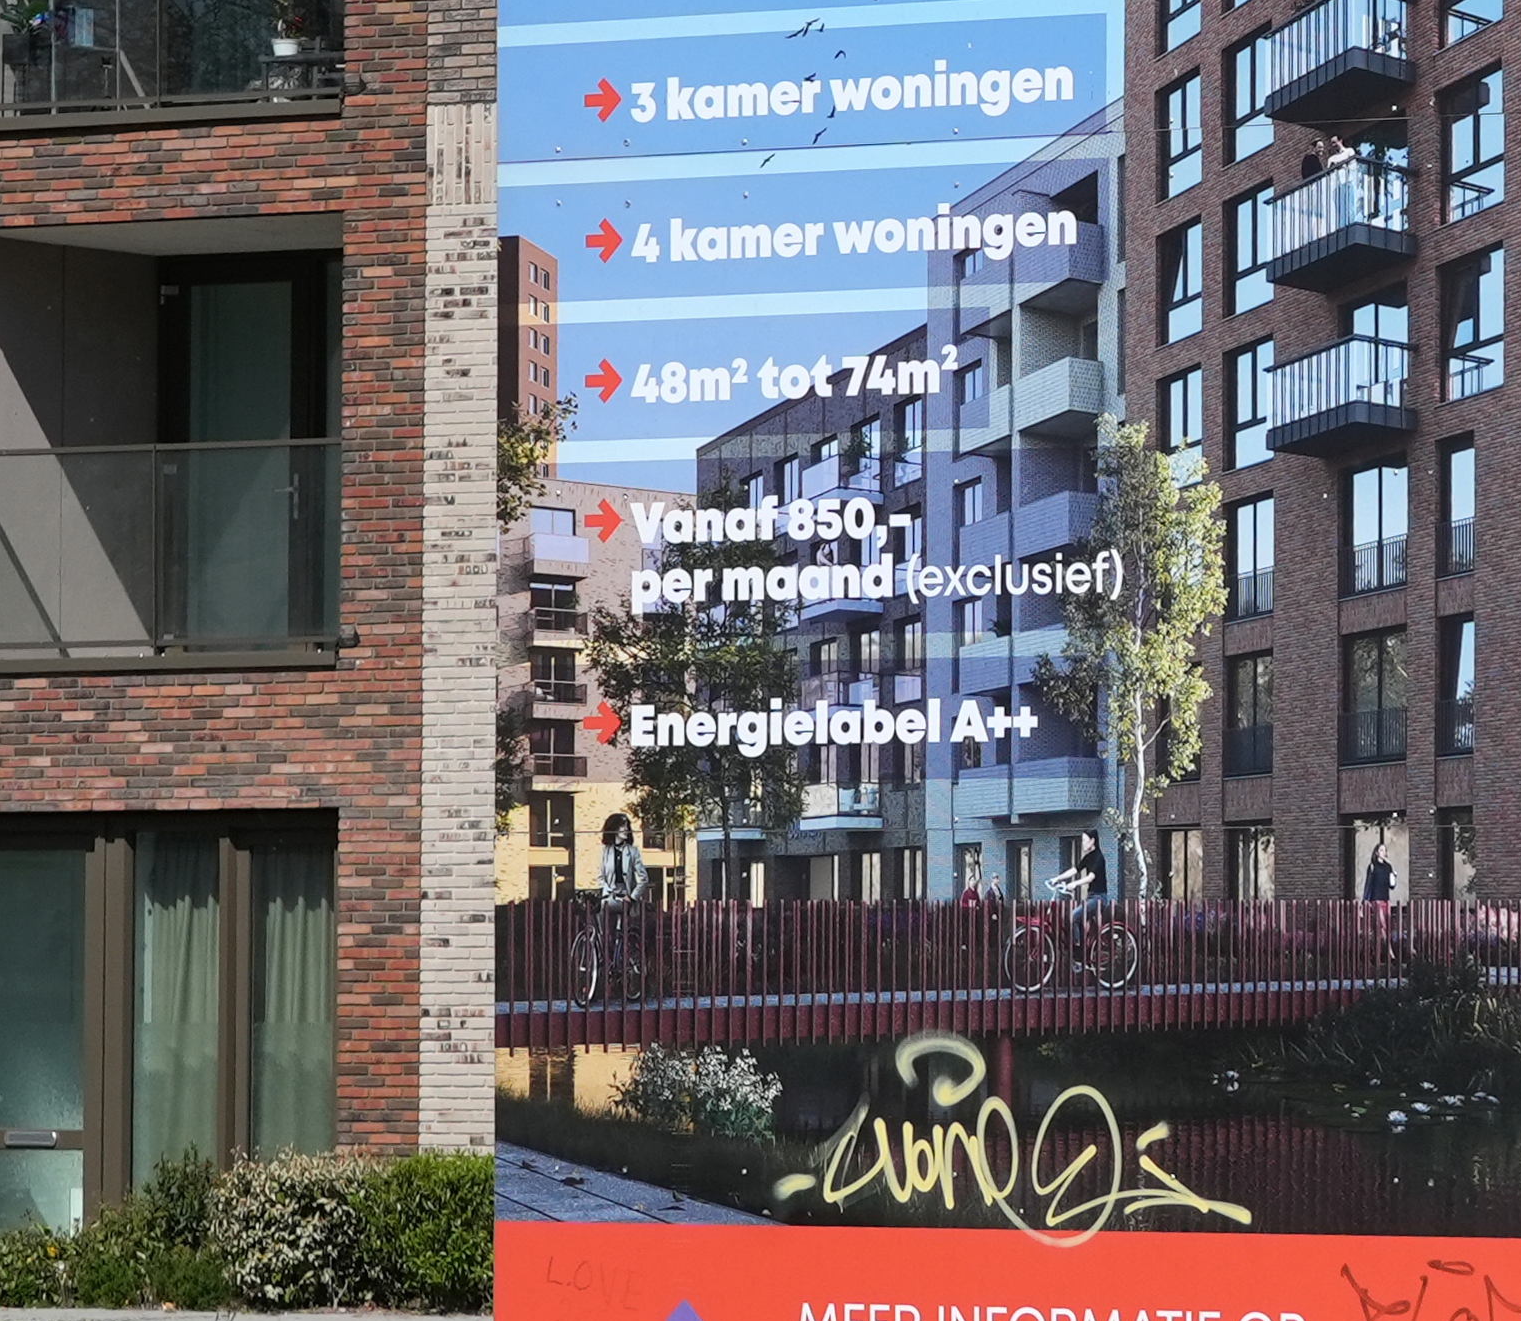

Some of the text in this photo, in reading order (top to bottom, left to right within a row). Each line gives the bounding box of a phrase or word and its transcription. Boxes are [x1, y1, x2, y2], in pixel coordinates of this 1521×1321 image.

[630, 59, 1074, 123] 3 kamer woningen
[631, 203, 1078, 263] 4 kamer woningen
[631, 344, 959, 403] 48m² tot 74m²
[630, 497, 912, 548] Vanaf 850,-
[631, 548, 1124, 615] per maand (exclusief)
[631, 698, 1039, 758] Energielabel A++
